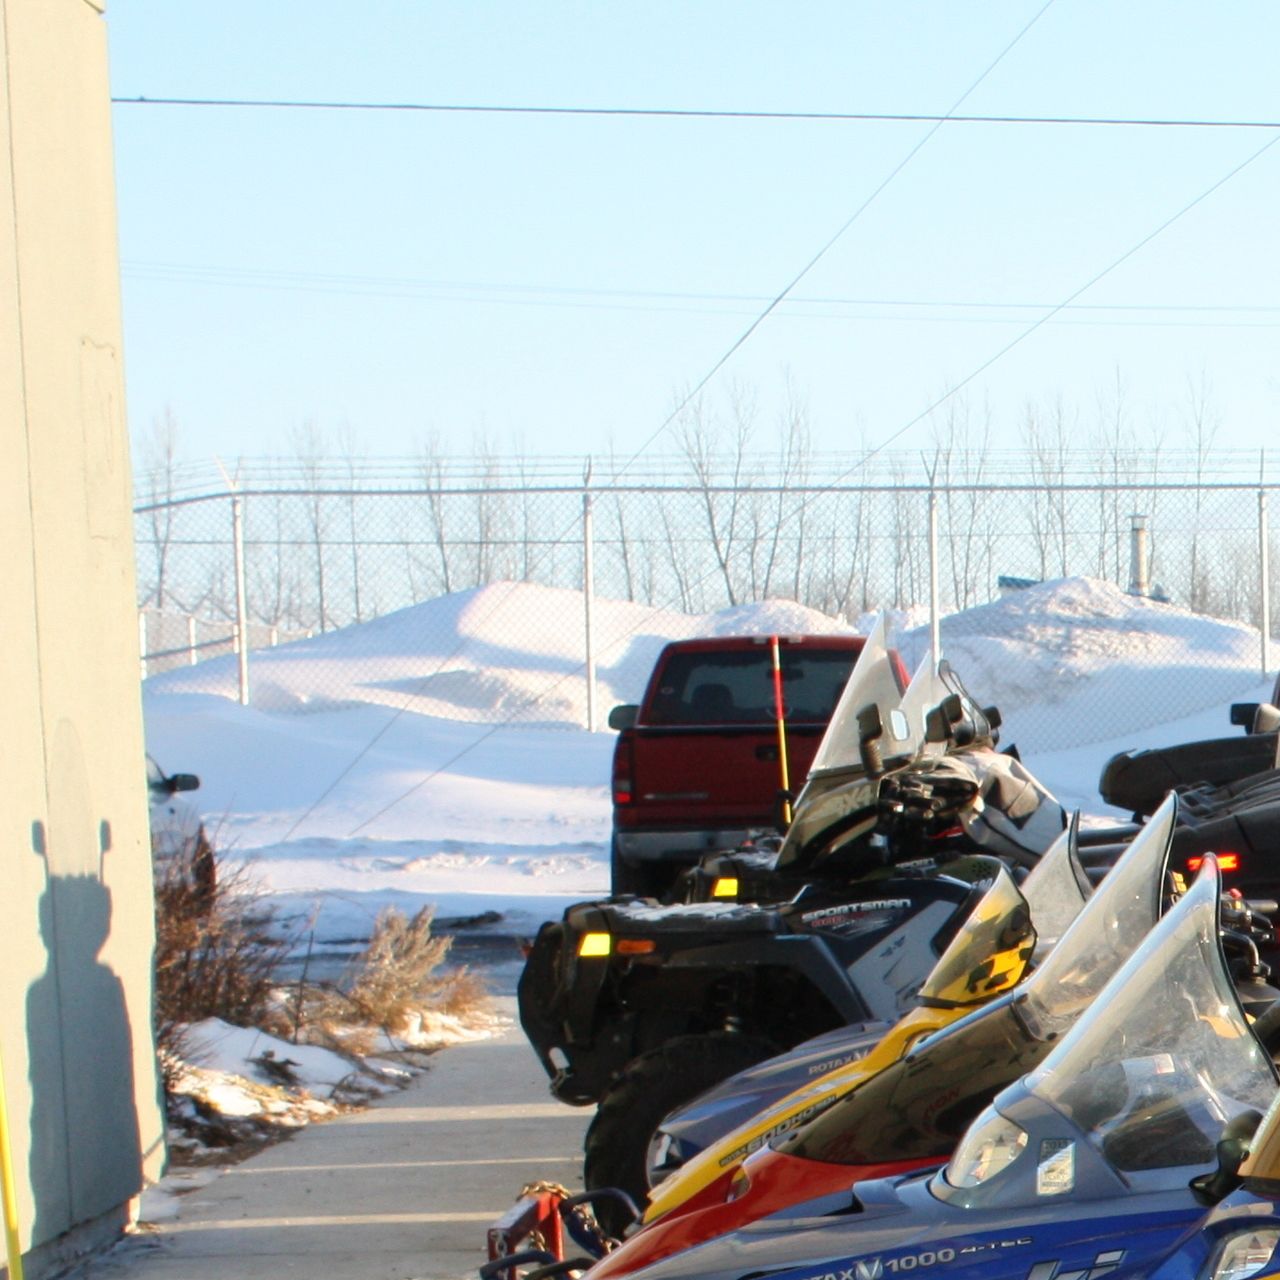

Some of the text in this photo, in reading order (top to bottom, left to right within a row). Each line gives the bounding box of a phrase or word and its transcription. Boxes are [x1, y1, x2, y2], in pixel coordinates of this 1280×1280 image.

[801, 898, 912, 924] SPORTSMAN
[885, 1247, 956, 1273] 1000
[960, 1236, 1033, 1254] 4-TEC
